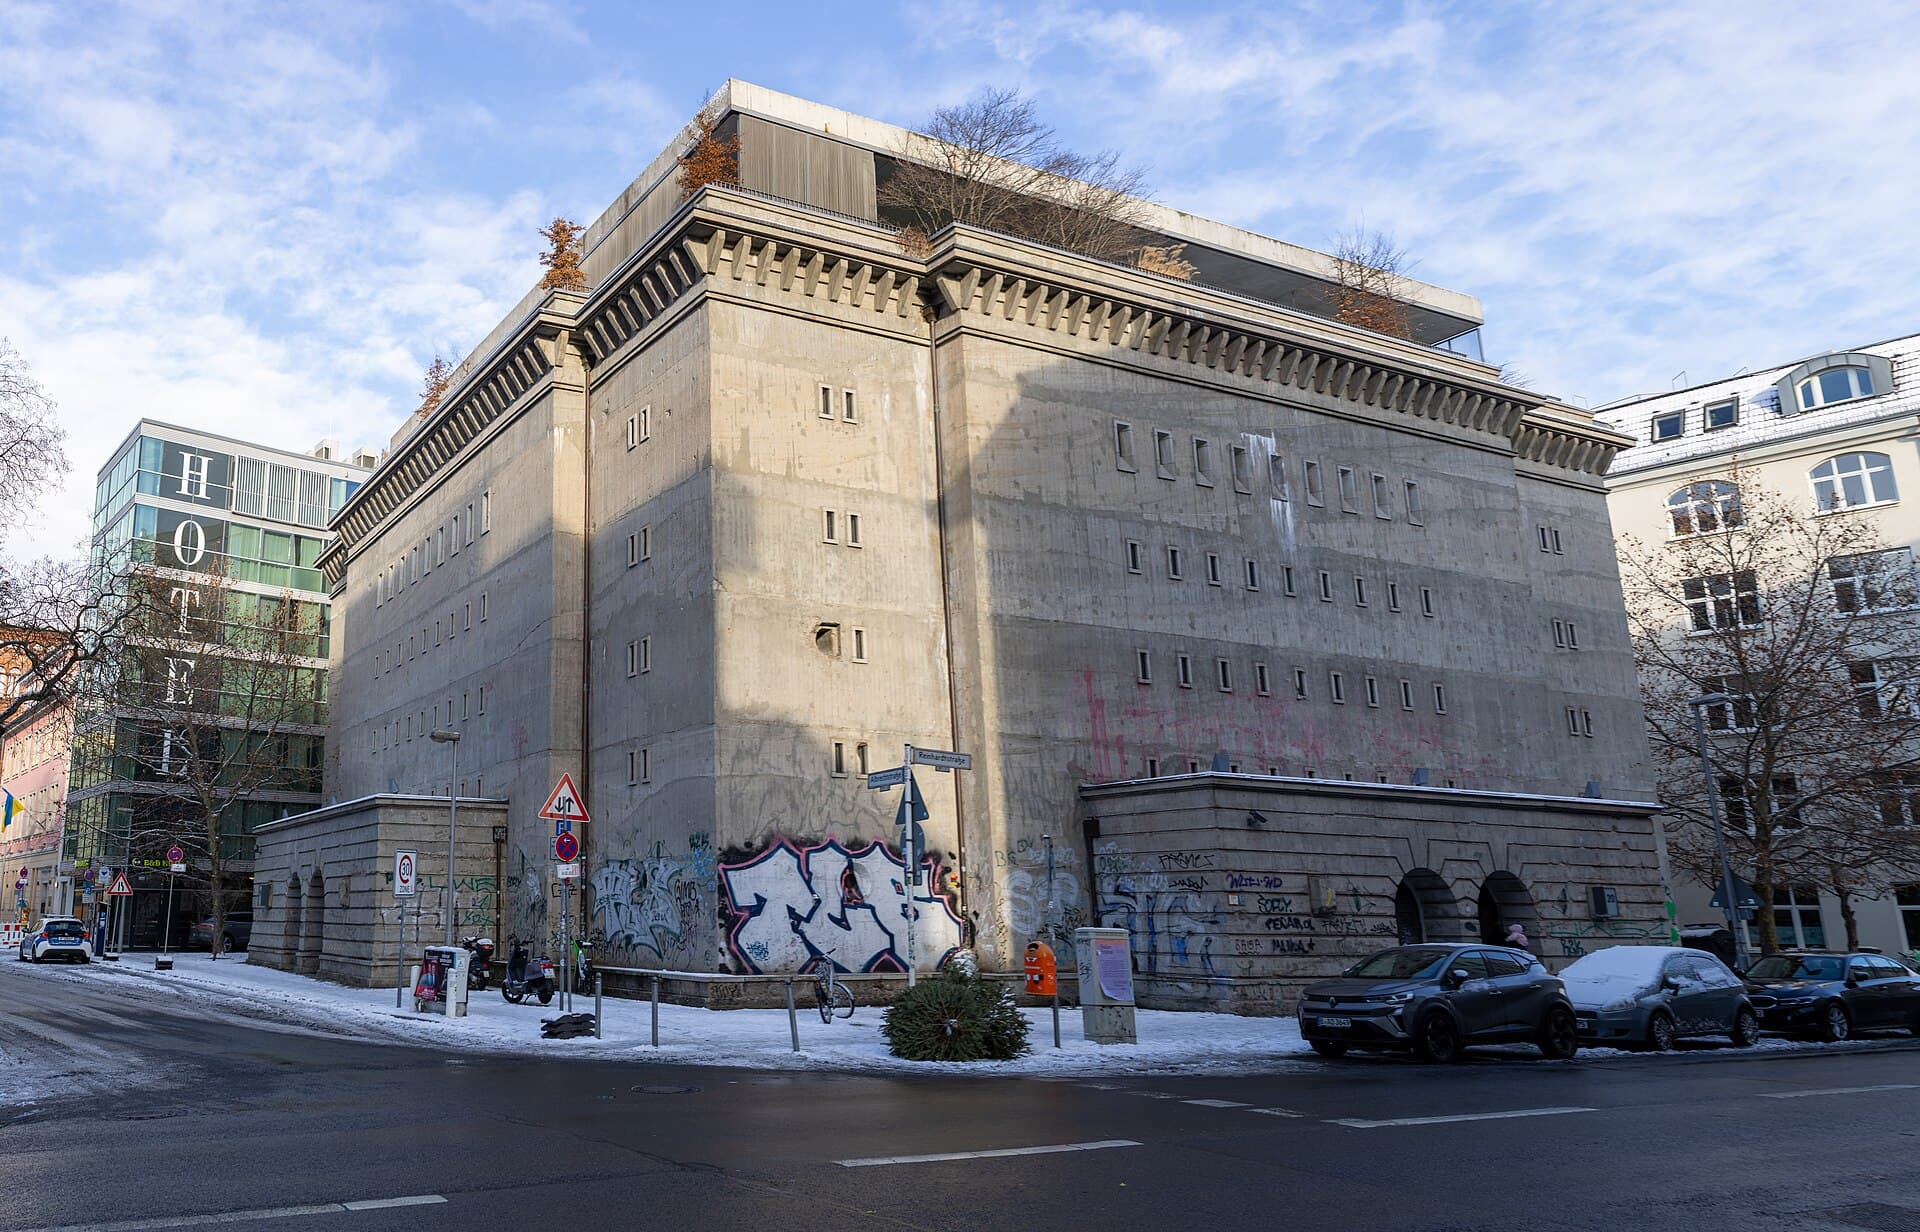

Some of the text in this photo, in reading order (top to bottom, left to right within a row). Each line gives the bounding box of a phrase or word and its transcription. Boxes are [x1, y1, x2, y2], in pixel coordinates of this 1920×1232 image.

[154, 451, 214, 779] HOTEL
[918, 751, 966, 766] Reinhardtstraße
[401, 862, 410, 876] 30
[399, 885, 411, 893] ZONE
